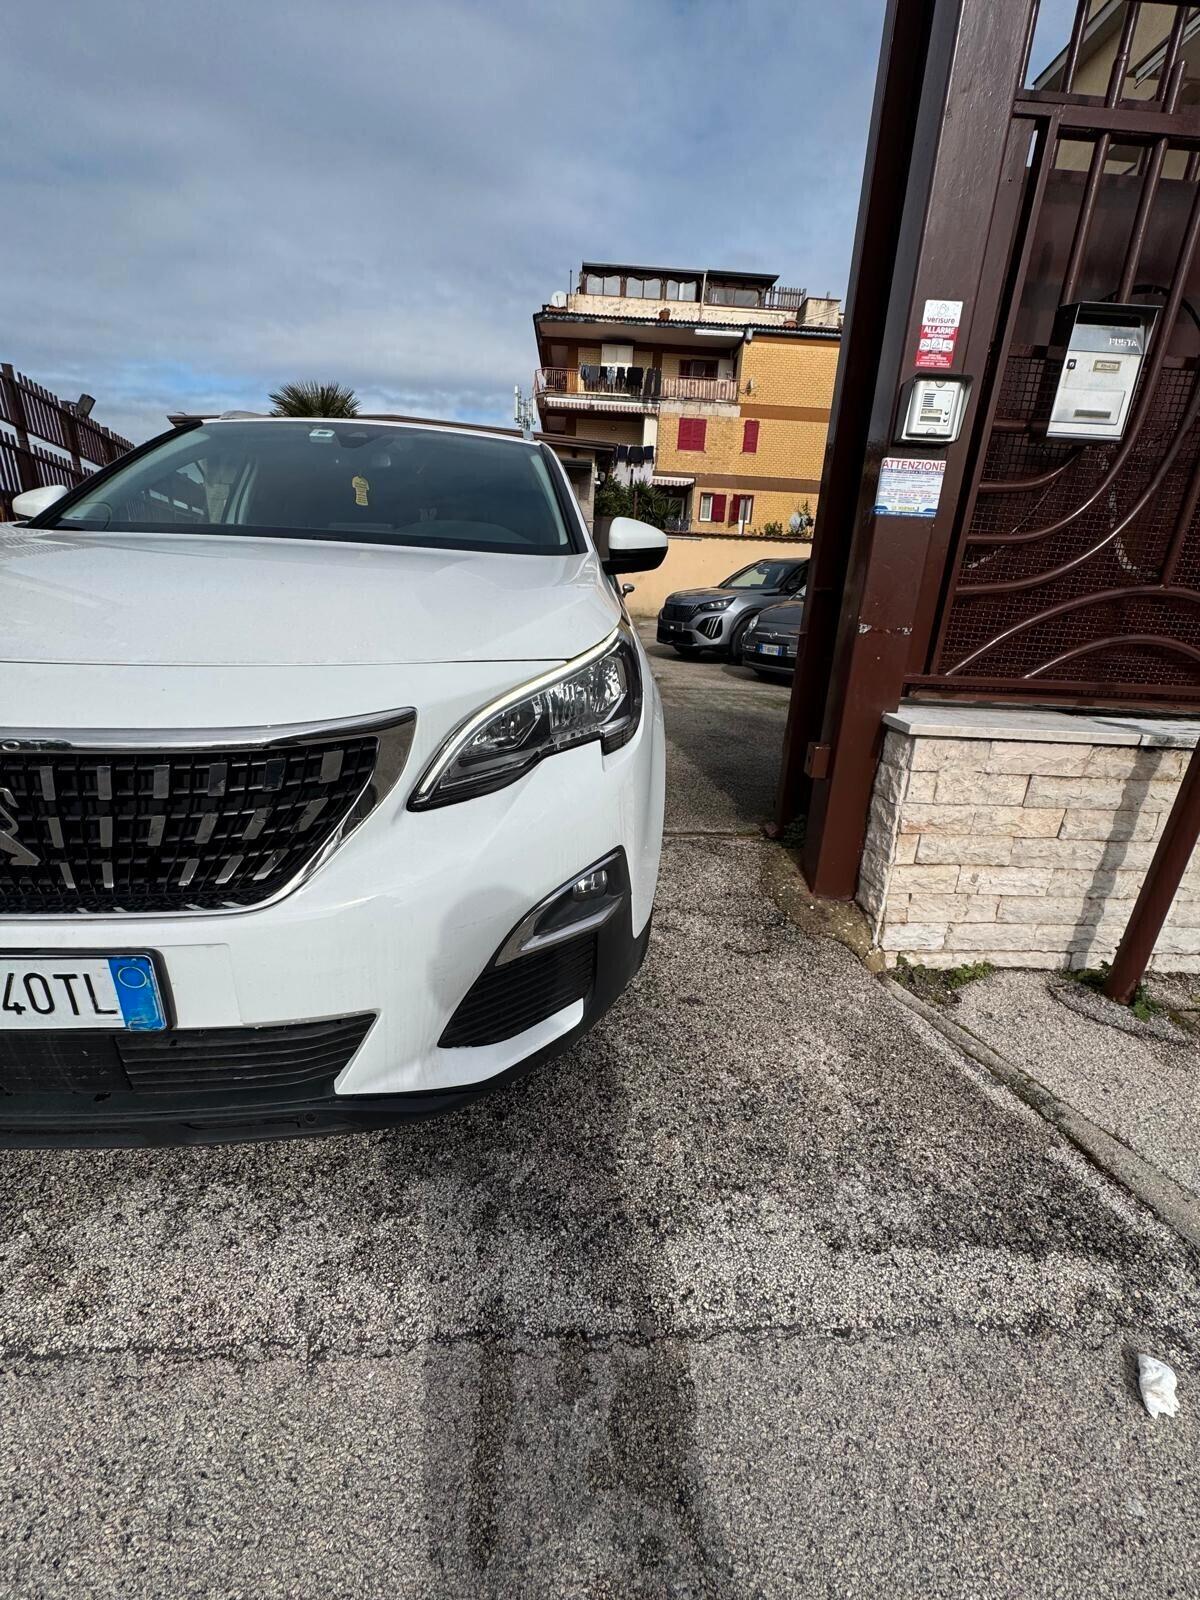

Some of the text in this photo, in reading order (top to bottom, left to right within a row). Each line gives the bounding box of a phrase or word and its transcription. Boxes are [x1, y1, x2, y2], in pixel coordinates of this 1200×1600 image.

[927, 316, 956, 325] verisure
[923, 326, 956, 335] ALLARME
[882, 459, 946, 471] ATTENZIONE
